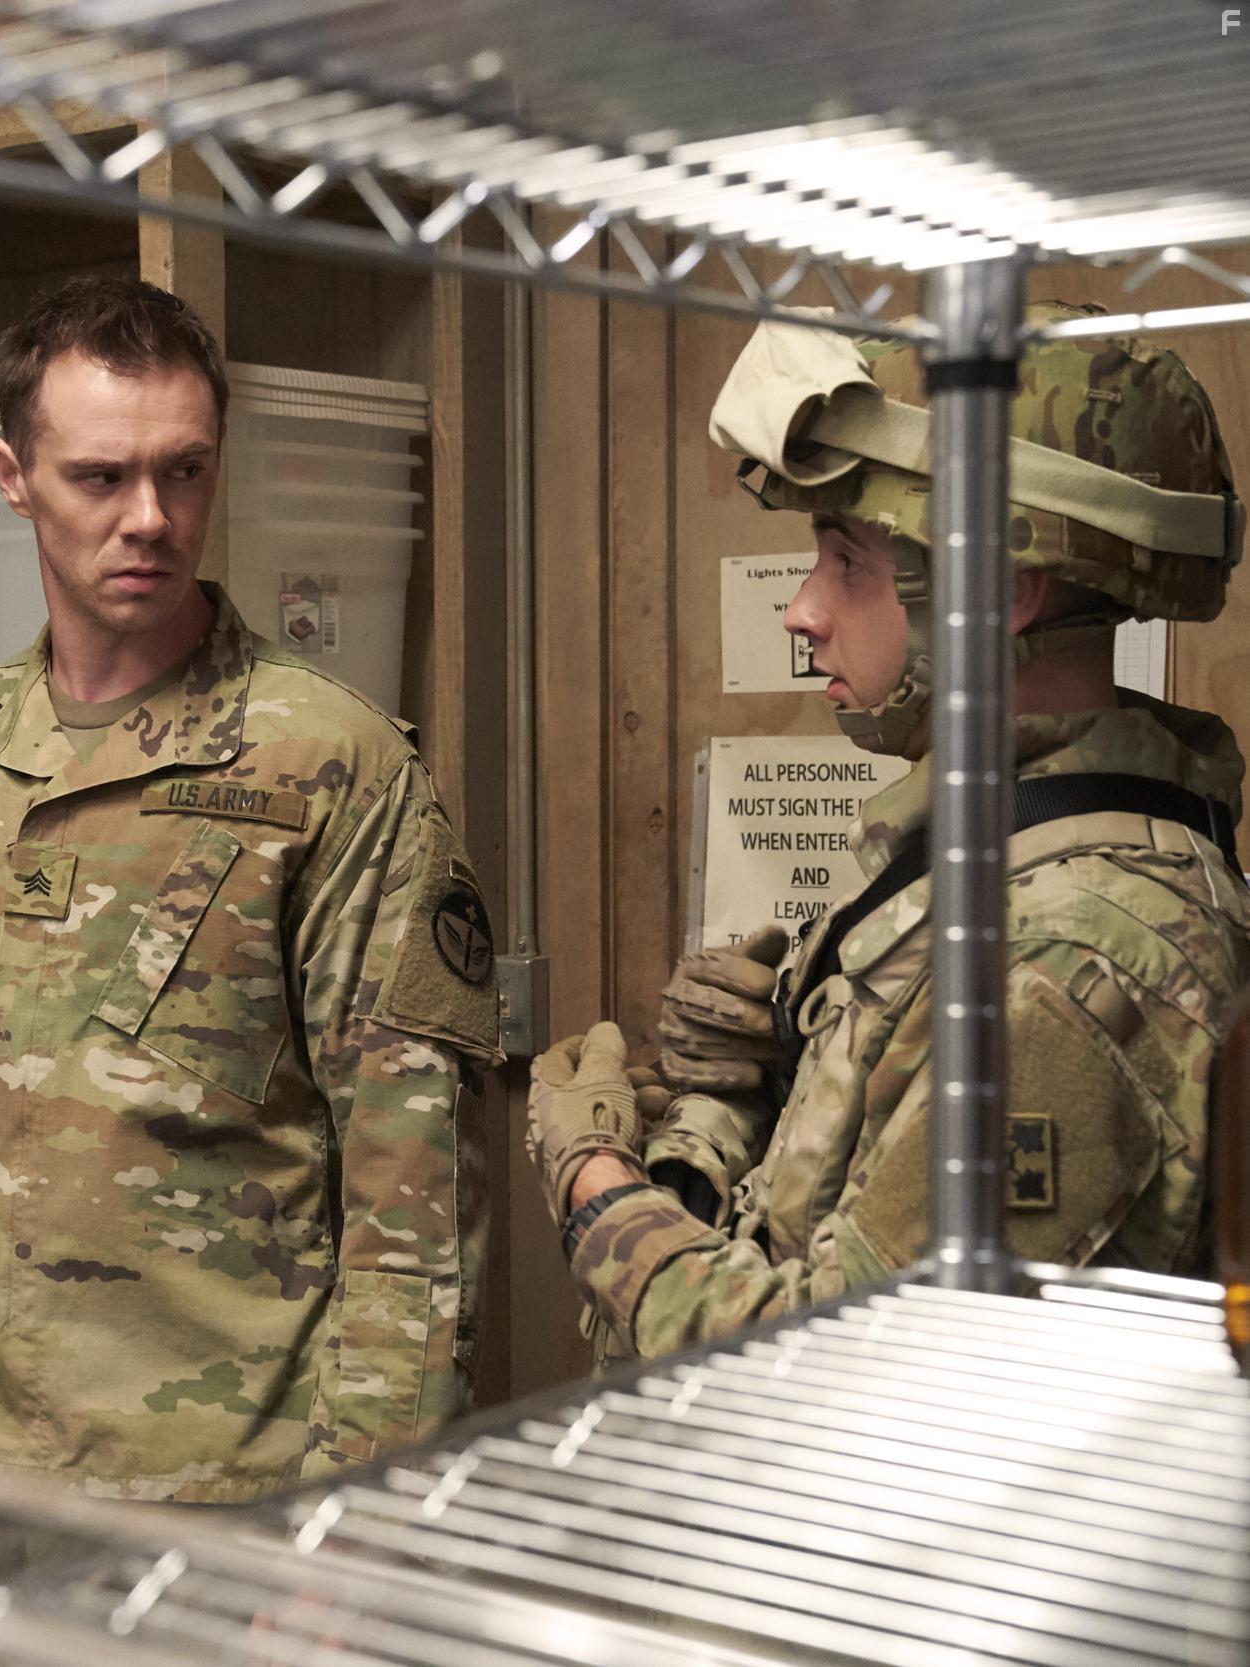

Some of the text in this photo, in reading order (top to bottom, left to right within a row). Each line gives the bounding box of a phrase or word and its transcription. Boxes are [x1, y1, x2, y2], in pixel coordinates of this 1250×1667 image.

[747, 568, 783, 580] Lights
[744, 763, 877, 782] ALL PERSONNEL
[728, 798, 775, 816] MUST
[778, 798, 817, 816] SIGN
[821, 798, 854, 816] THE
[741, 832, 852, 851] WHEN ENTER
[791, 867, 830, 885] AND
